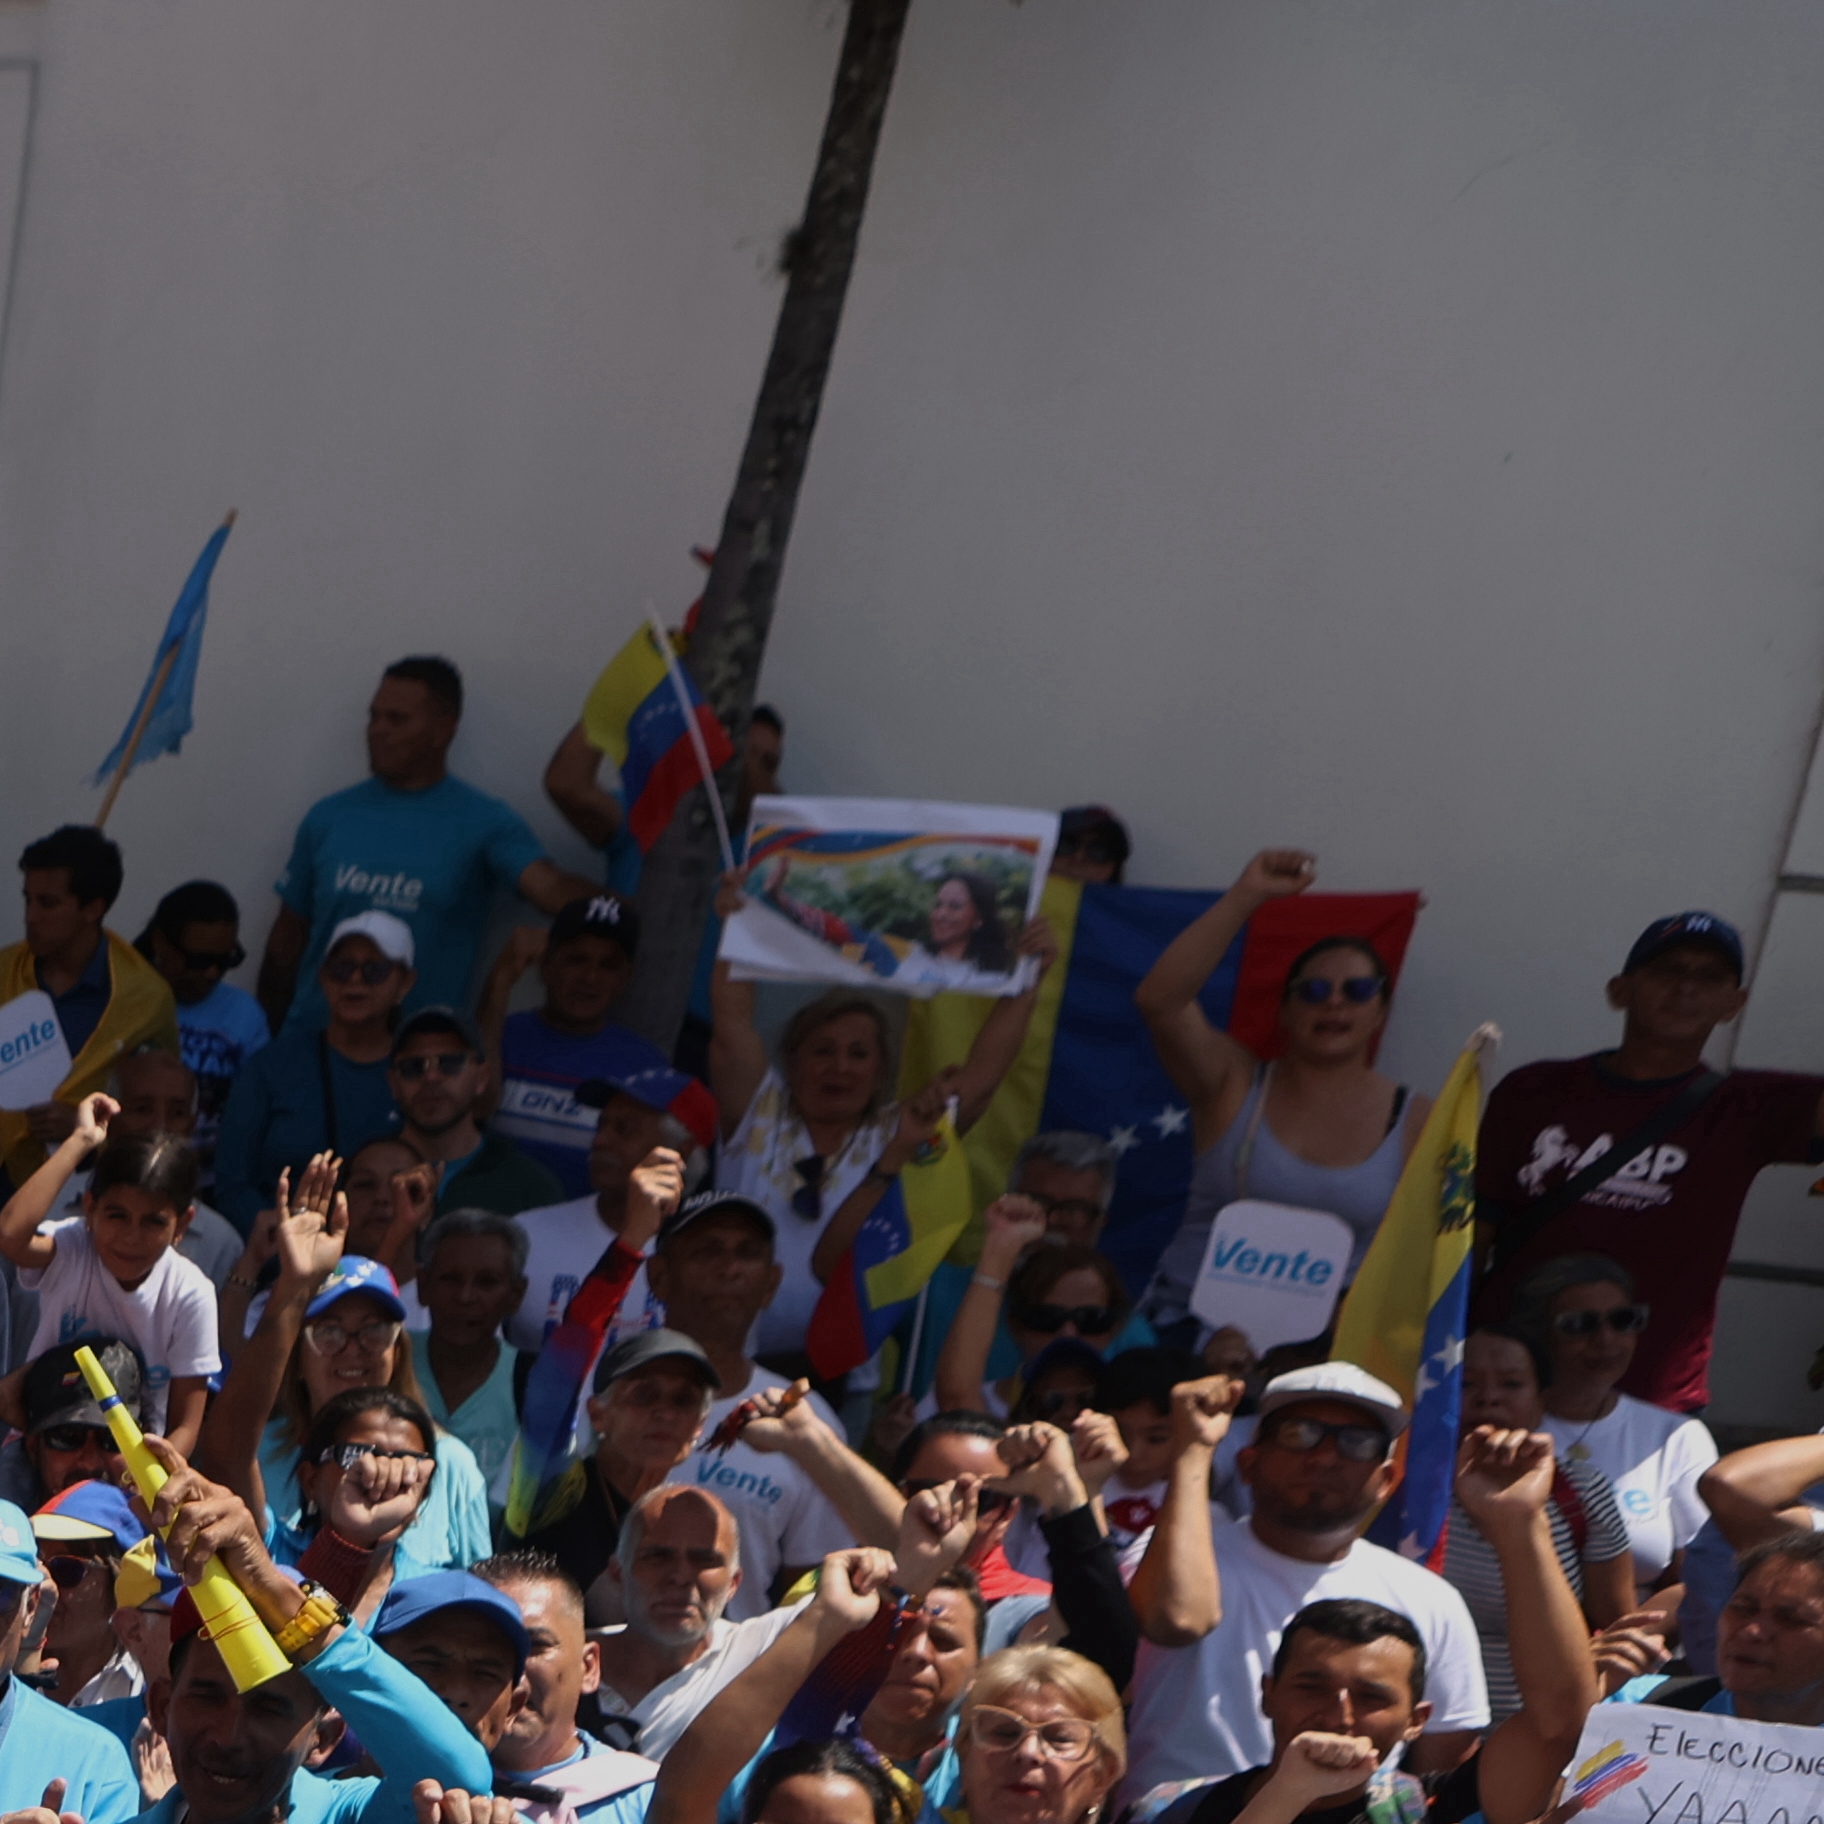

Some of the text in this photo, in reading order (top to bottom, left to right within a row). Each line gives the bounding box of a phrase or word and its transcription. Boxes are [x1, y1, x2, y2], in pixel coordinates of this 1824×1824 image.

[335, 864, 424, 900] Vente
[1212, 1232, 1333, 1286] Vente
[696, 1456, 784, 1506] Vente
